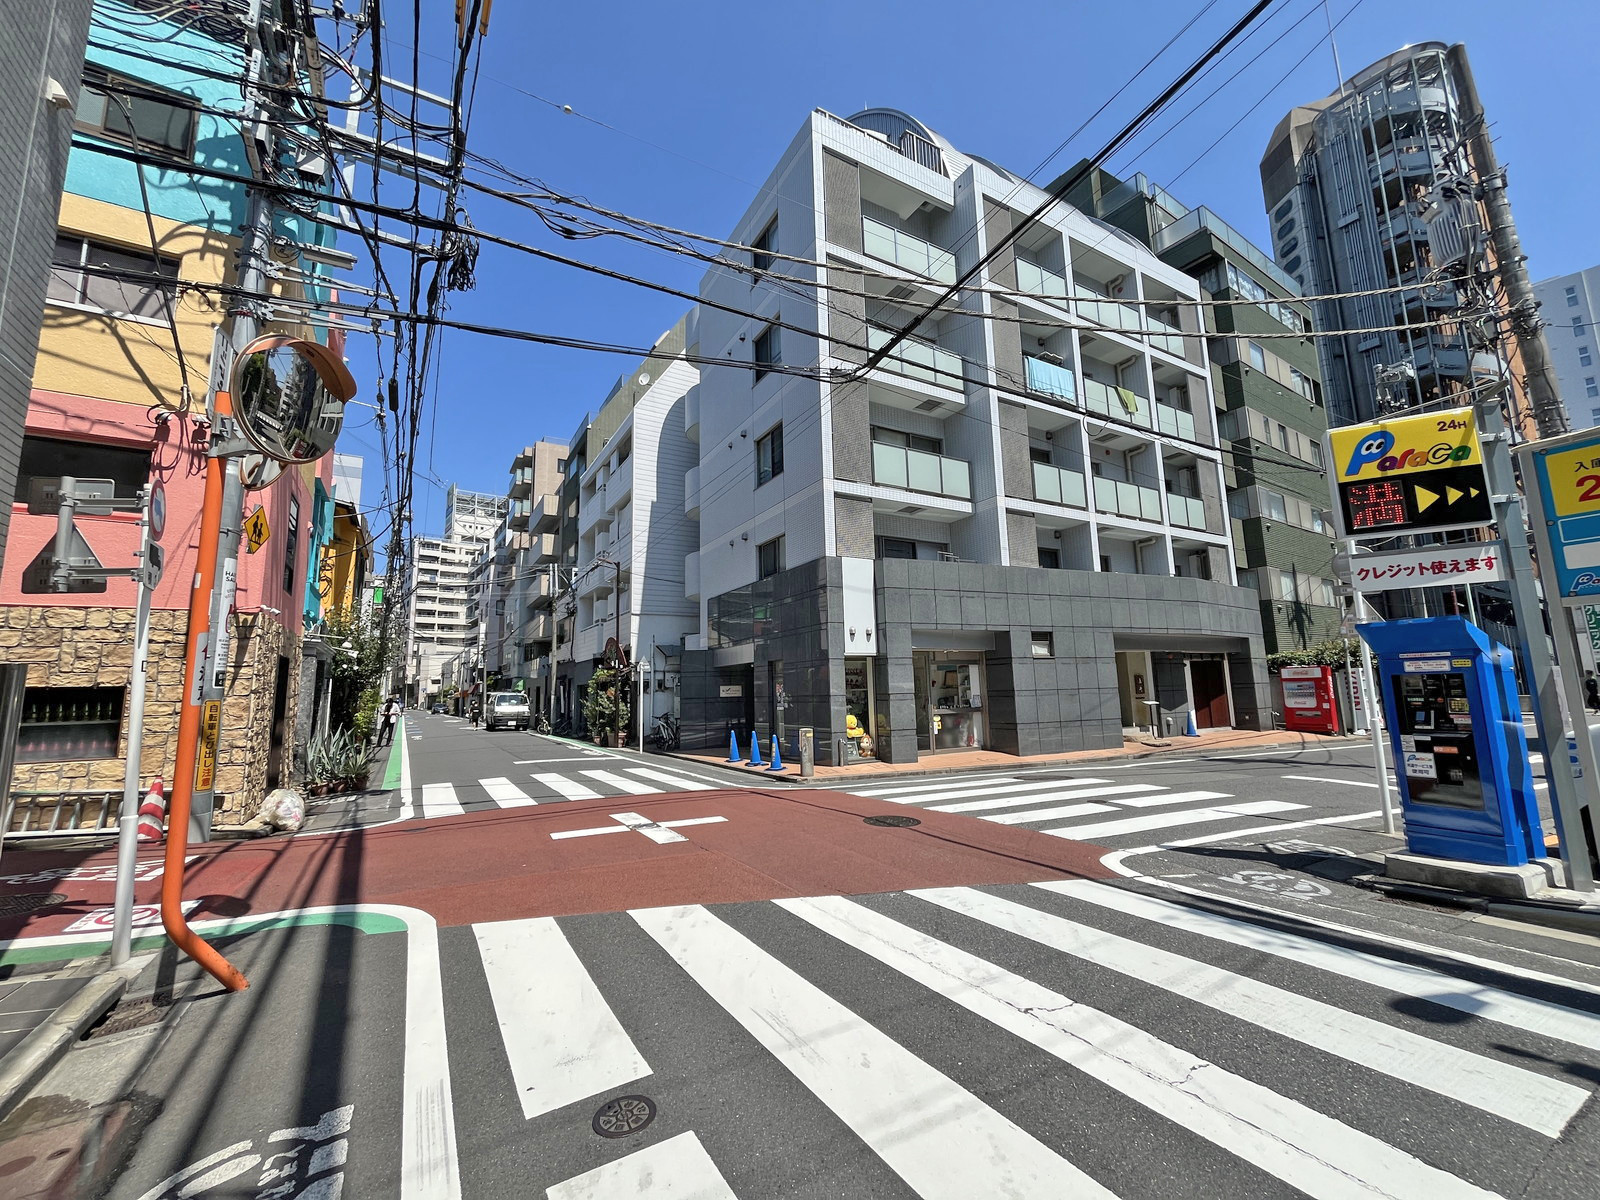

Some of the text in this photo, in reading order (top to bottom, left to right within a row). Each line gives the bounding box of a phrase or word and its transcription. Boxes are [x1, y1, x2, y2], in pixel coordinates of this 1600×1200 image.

[1437, 420, 1467, 432] 24H
[1350, 483, 1404, 527] 満
[1357, 556, 1498, 581] クレジット使えます
[201, 704, 219, 787] 自転車とび出し注意
